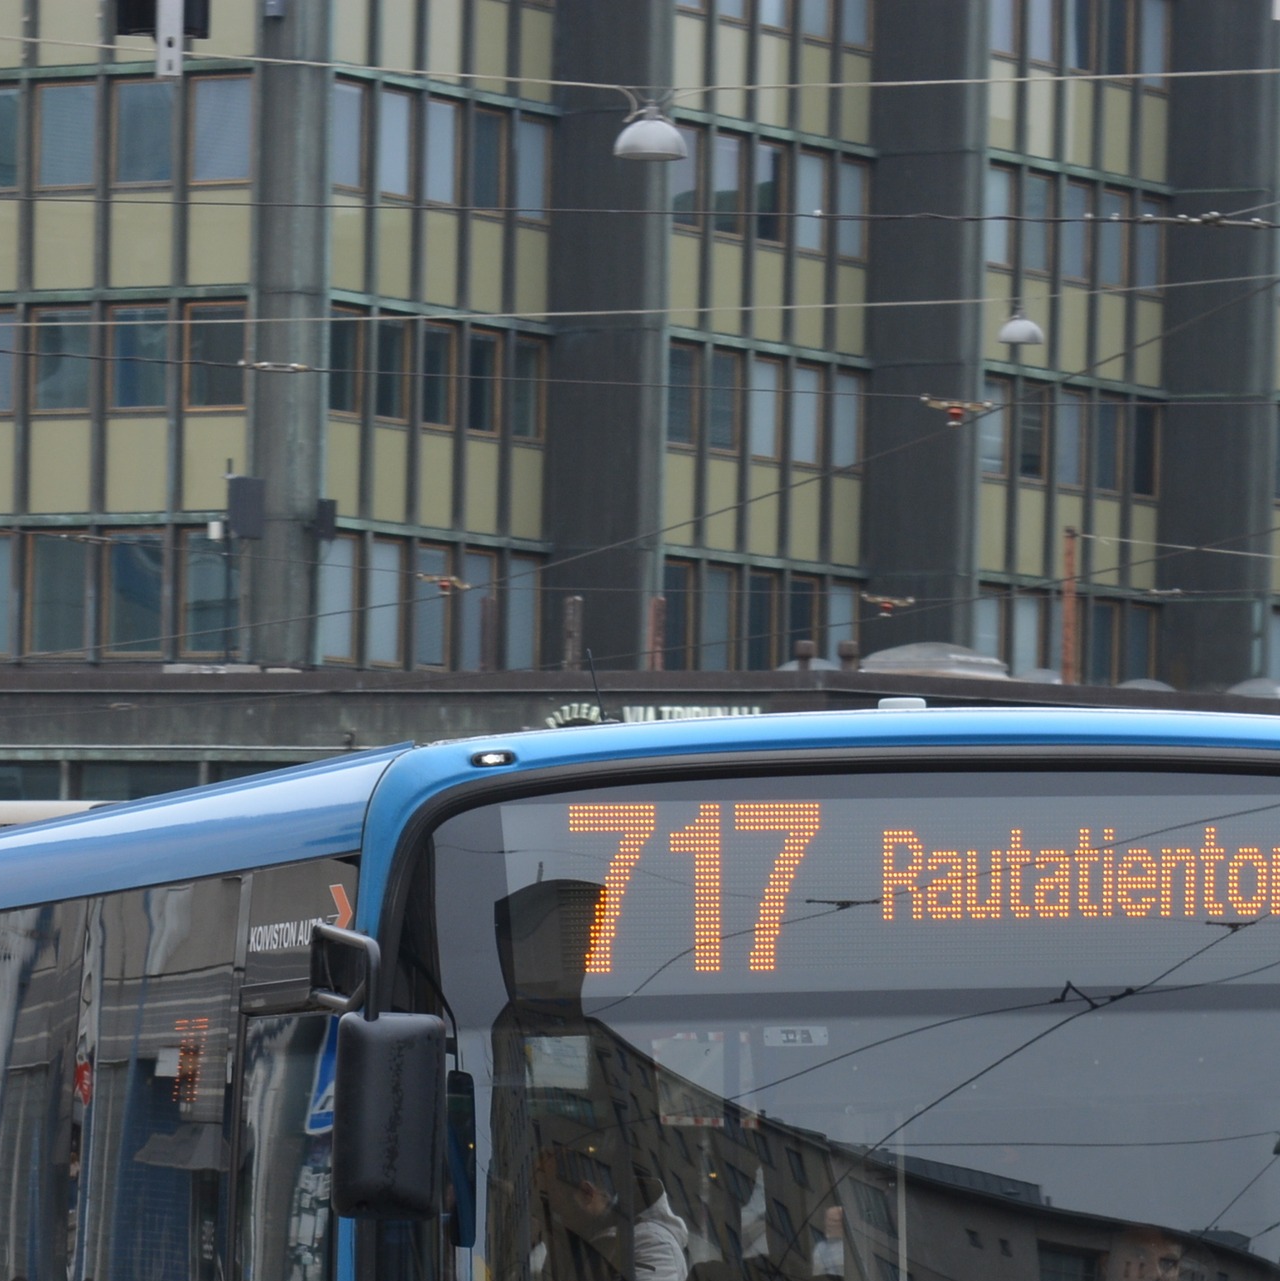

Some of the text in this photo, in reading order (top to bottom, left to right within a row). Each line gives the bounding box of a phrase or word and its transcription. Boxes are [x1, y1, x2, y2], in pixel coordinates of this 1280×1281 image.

[622, 706, 656, 722] VIA
[569, 803, 819, 973] 717
[249, 921, 297, 952] KOIVISTON
